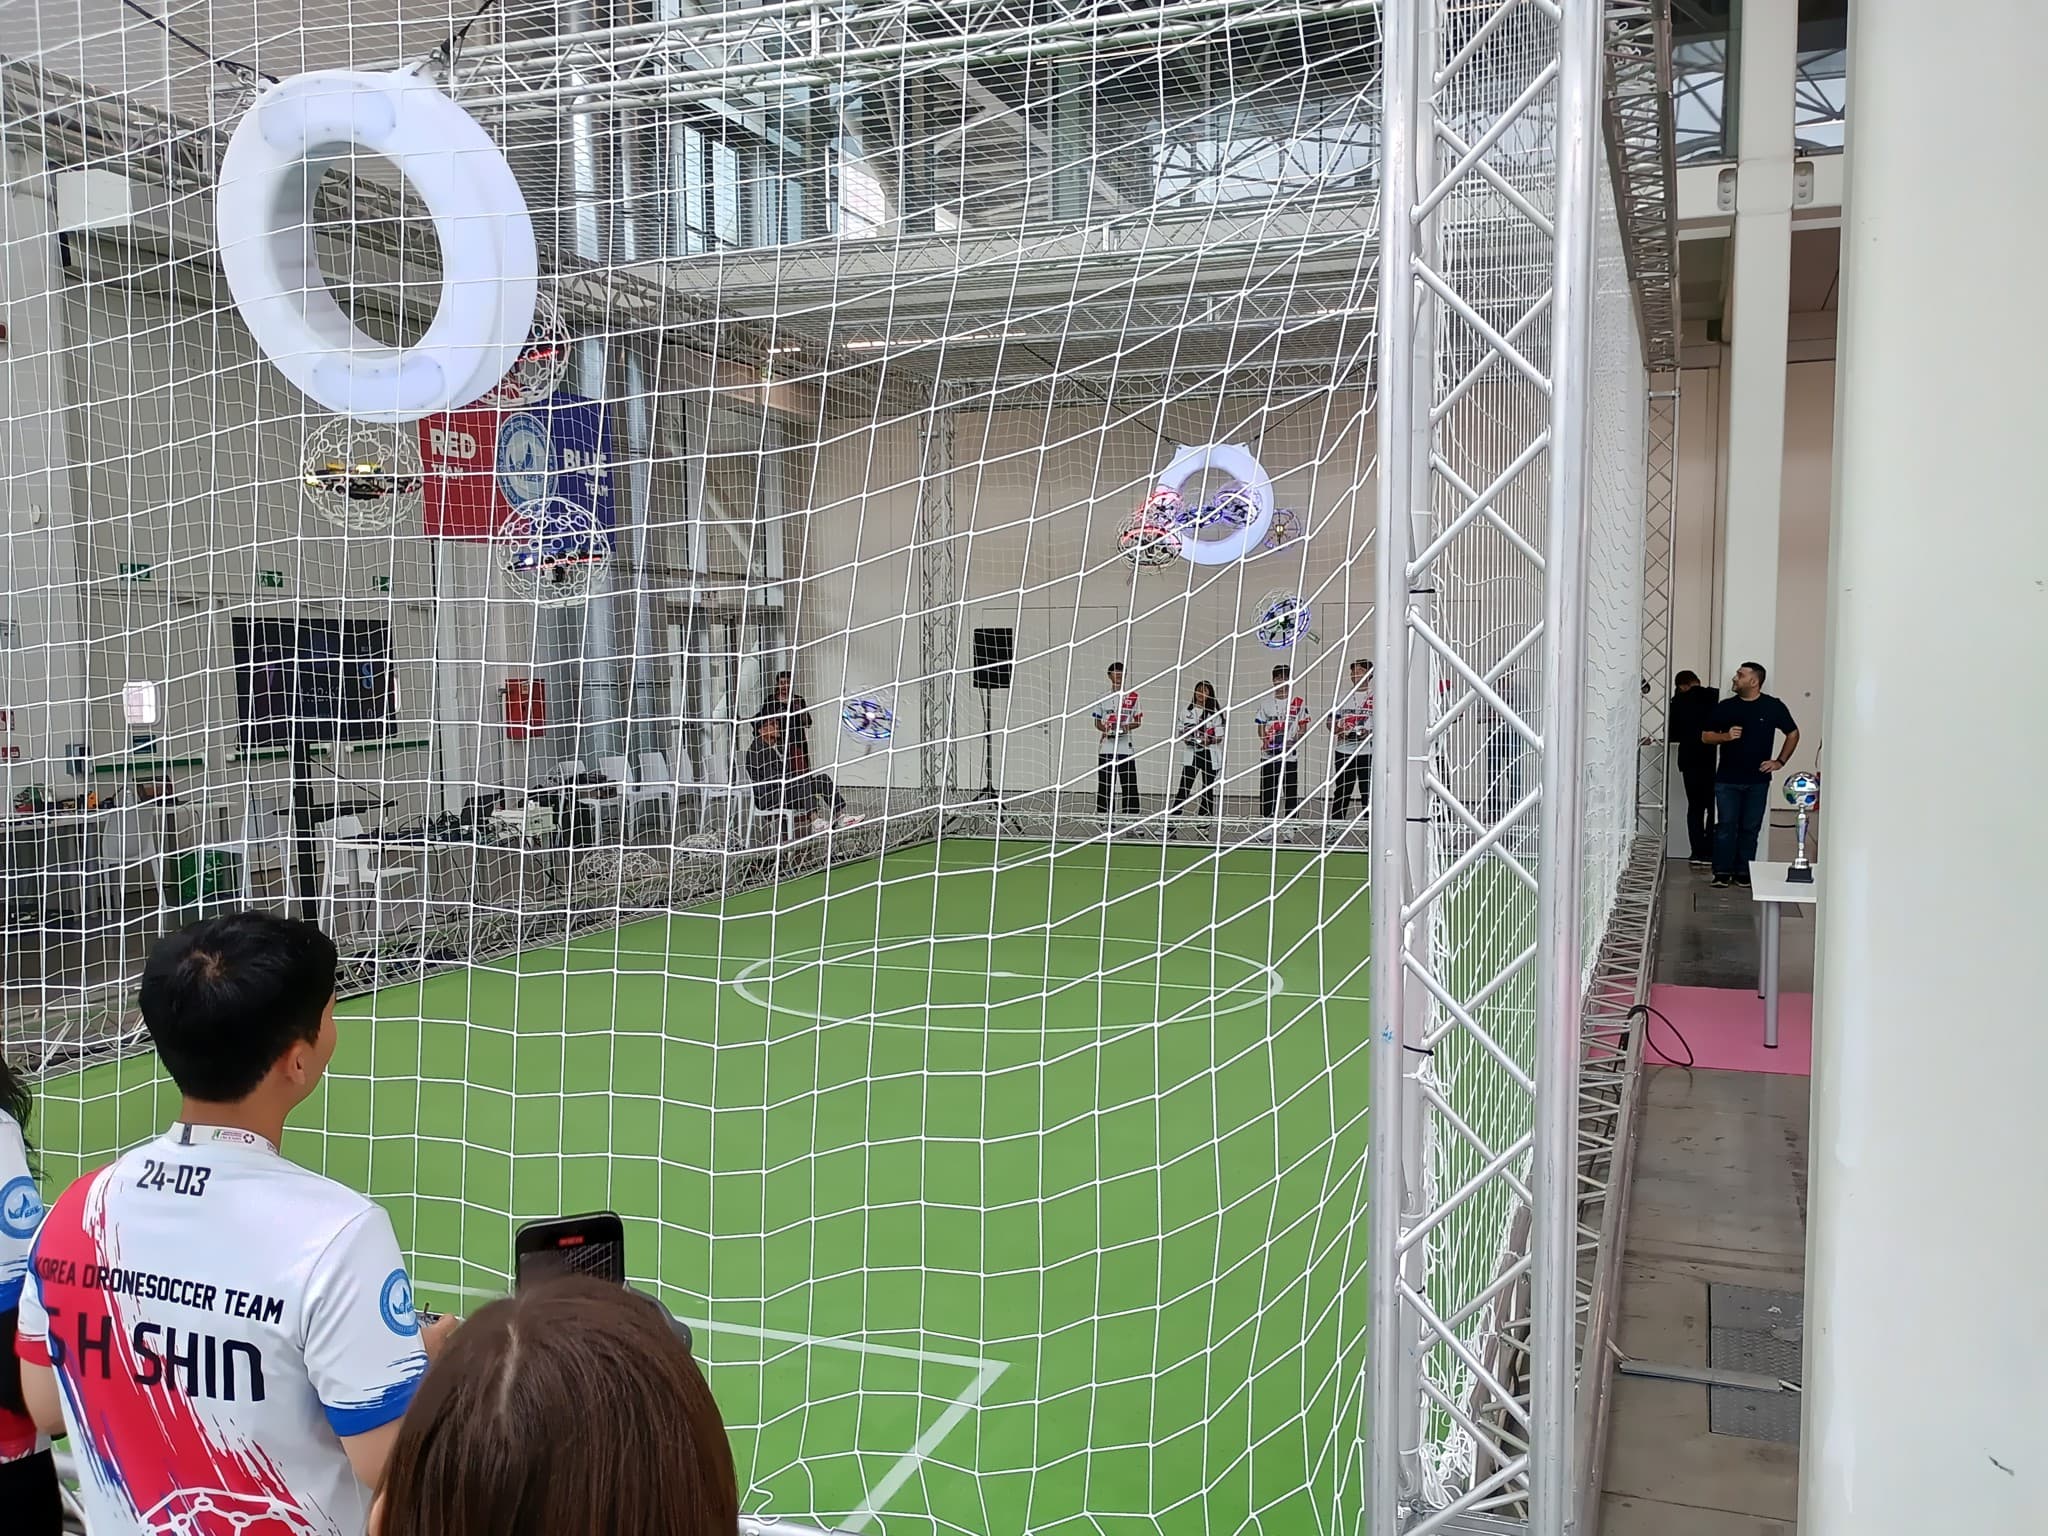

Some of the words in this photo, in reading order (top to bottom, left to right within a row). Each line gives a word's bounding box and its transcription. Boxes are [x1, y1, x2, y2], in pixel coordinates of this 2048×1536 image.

[430, 428, 476, 459] RED
[431, 463, 464, 480] TEAM
[563, 447, 608, 478] BLUE
[136, 1159, 212, 1197] 24-03
[82, 1263, 217, 1311] DRONESOCCER
[224, 1288, 285, 1324] TEAM
[133, 1321, 266, 1402] SHIN
